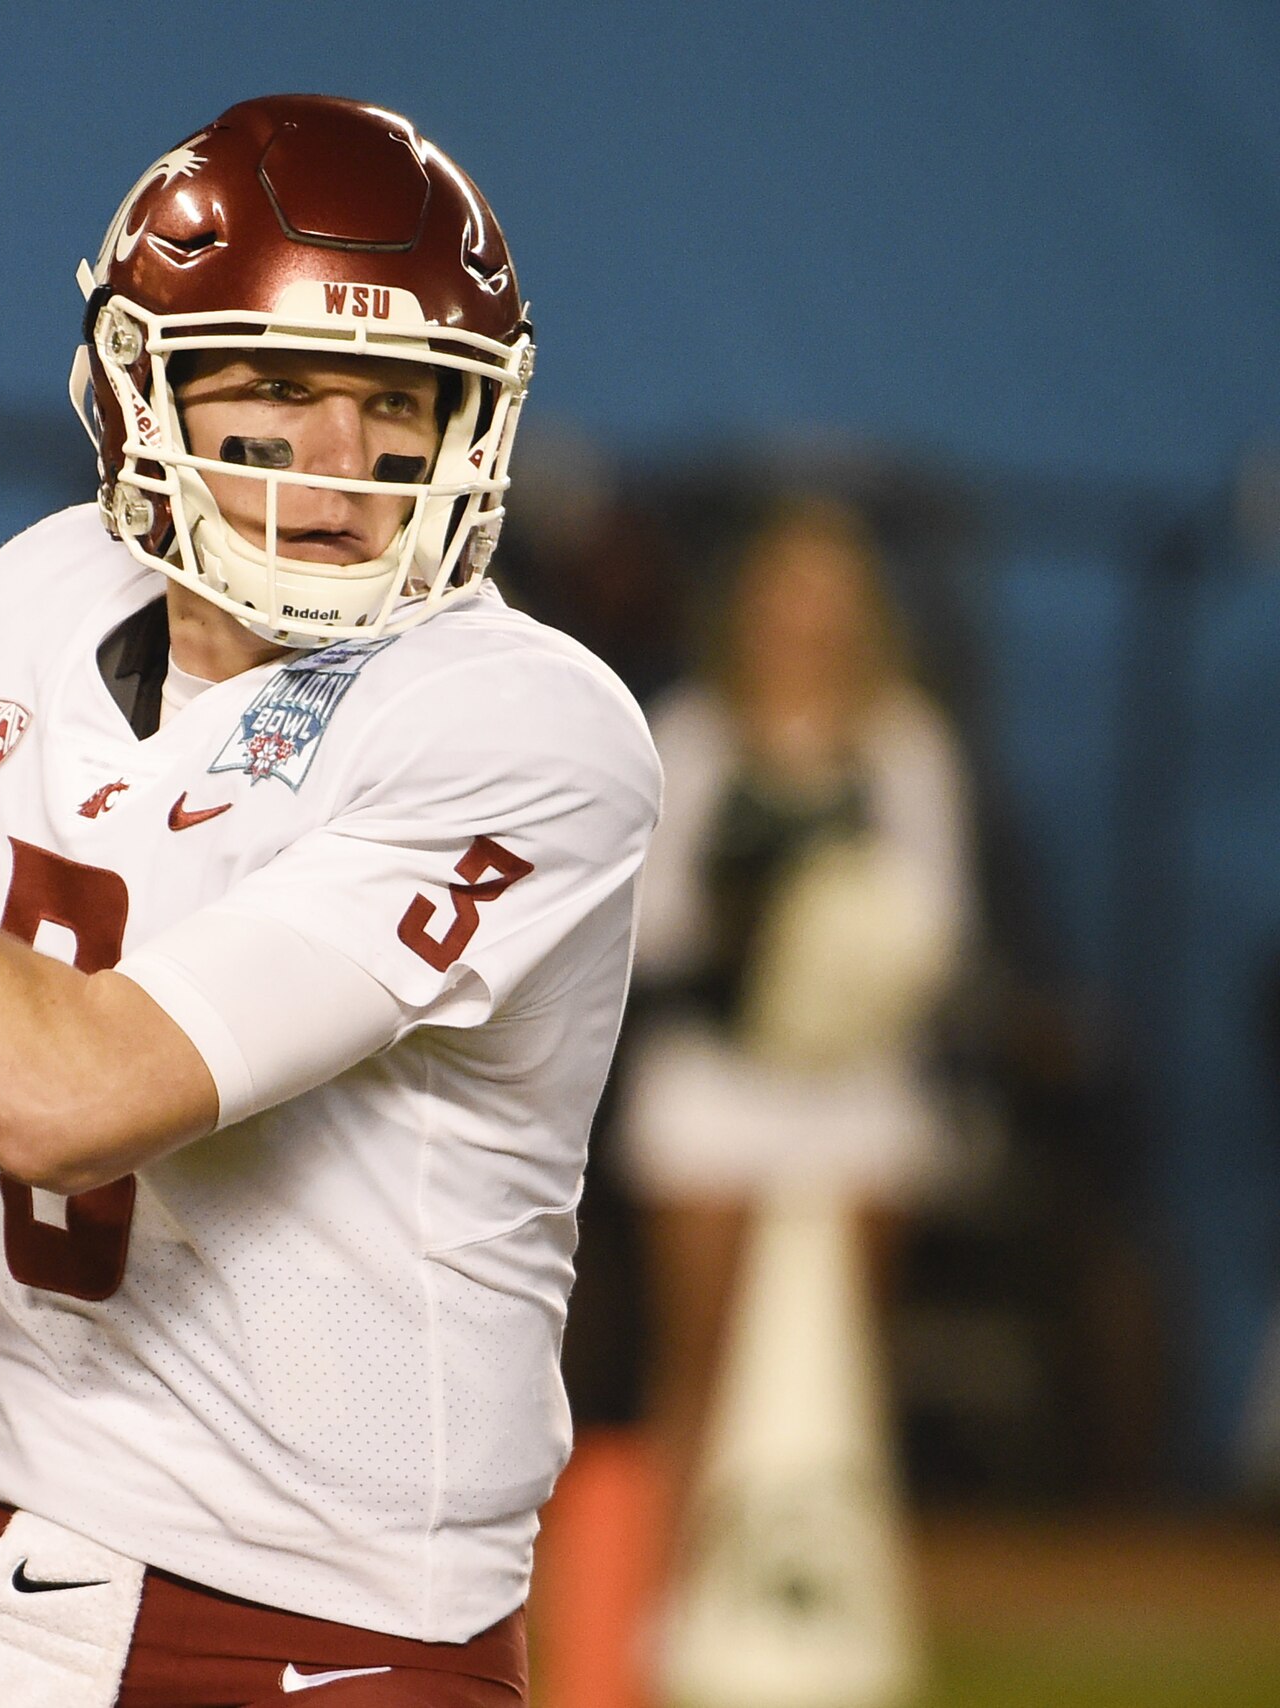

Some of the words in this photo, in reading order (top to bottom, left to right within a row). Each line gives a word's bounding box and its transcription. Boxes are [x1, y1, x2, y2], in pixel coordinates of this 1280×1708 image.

[323, 283, 390, 320] WSU
[282, 604, 339, 620] Riddell
[247, 672, 352, 723] HOLIDAY
[250, 709, 312, 740] BOWL
[397, 834, 535, 974] 3
